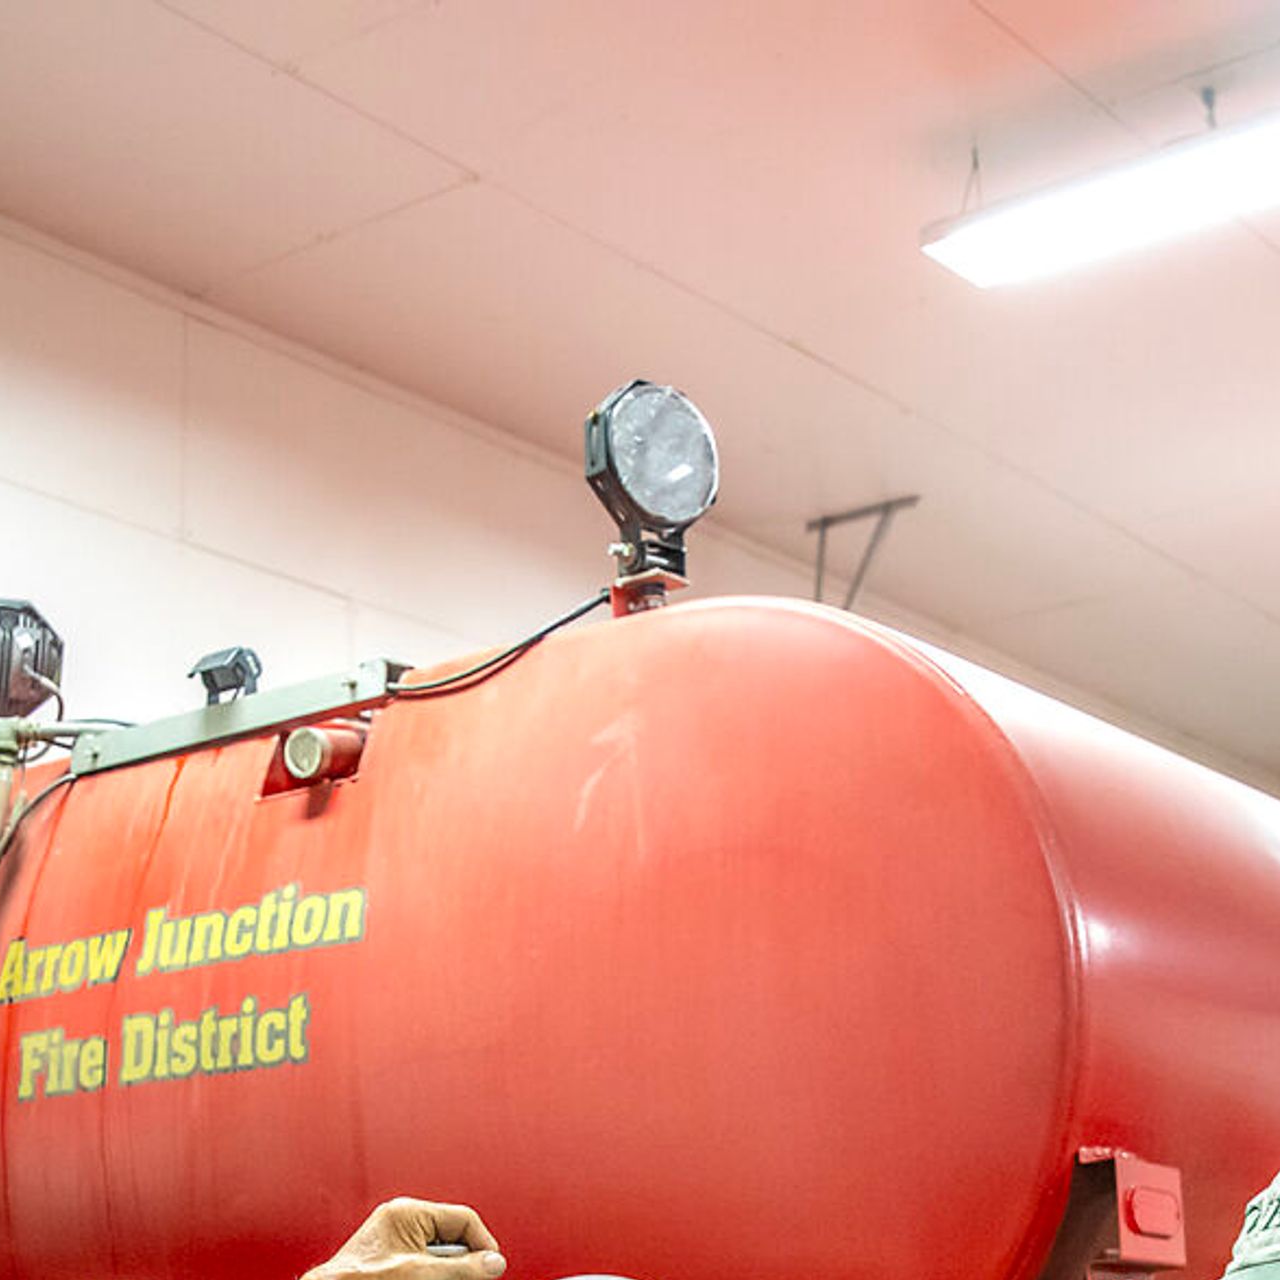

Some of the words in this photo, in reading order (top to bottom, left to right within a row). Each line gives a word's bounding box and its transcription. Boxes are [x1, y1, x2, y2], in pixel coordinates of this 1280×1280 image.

[135, 882, 366, 977] Junction
[18, 1028, 107, 1101] Fire
[119, 993, 311, 1086] District
